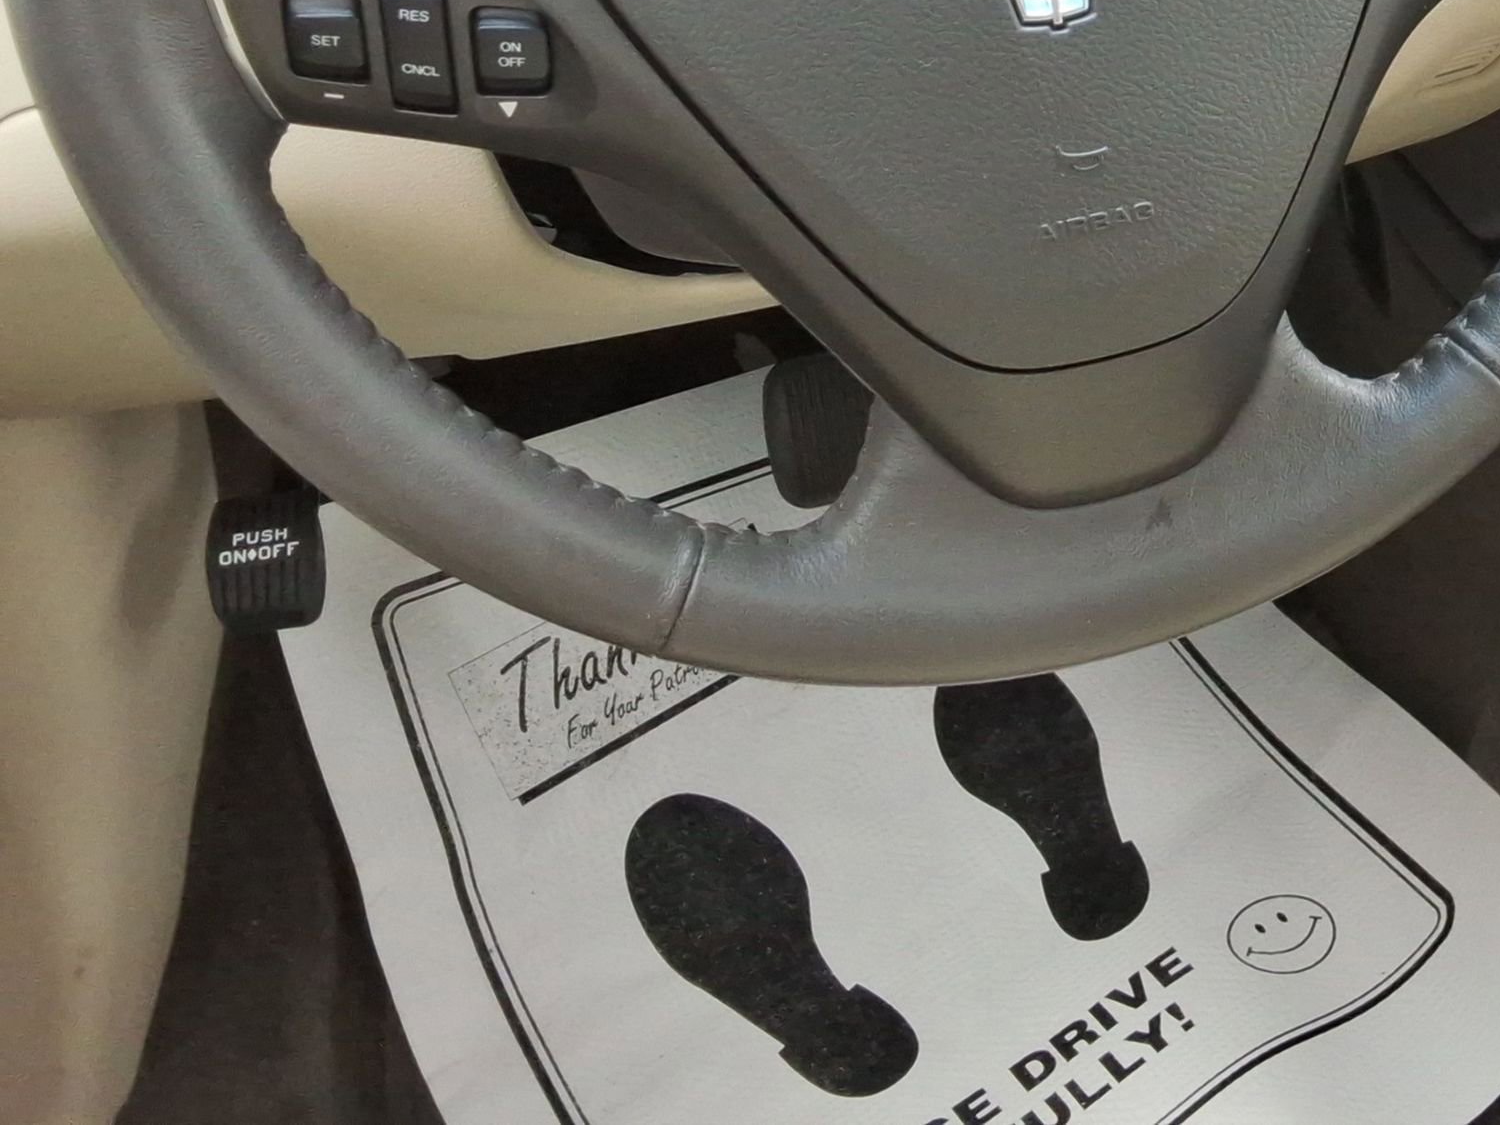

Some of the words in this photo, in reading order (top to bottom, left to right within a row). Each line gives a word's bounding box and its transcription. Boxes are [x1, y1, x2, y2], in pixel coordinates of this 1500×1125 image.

[399, 9, 430, 23] RES
[311, 34, 341, 47] SET
[500, 41, 522, 53] ON
[498, 55, 526, 68] OFF
[401, 64, 441, 78] CNCL
[232, 527, 289, 548] PUSH
[568, 714, 598, 749] For
[604, 692, 644, 726] Your
[650, 664, 705, 701] Patro
[1008, 946, 1195, 1093] DRIVE
